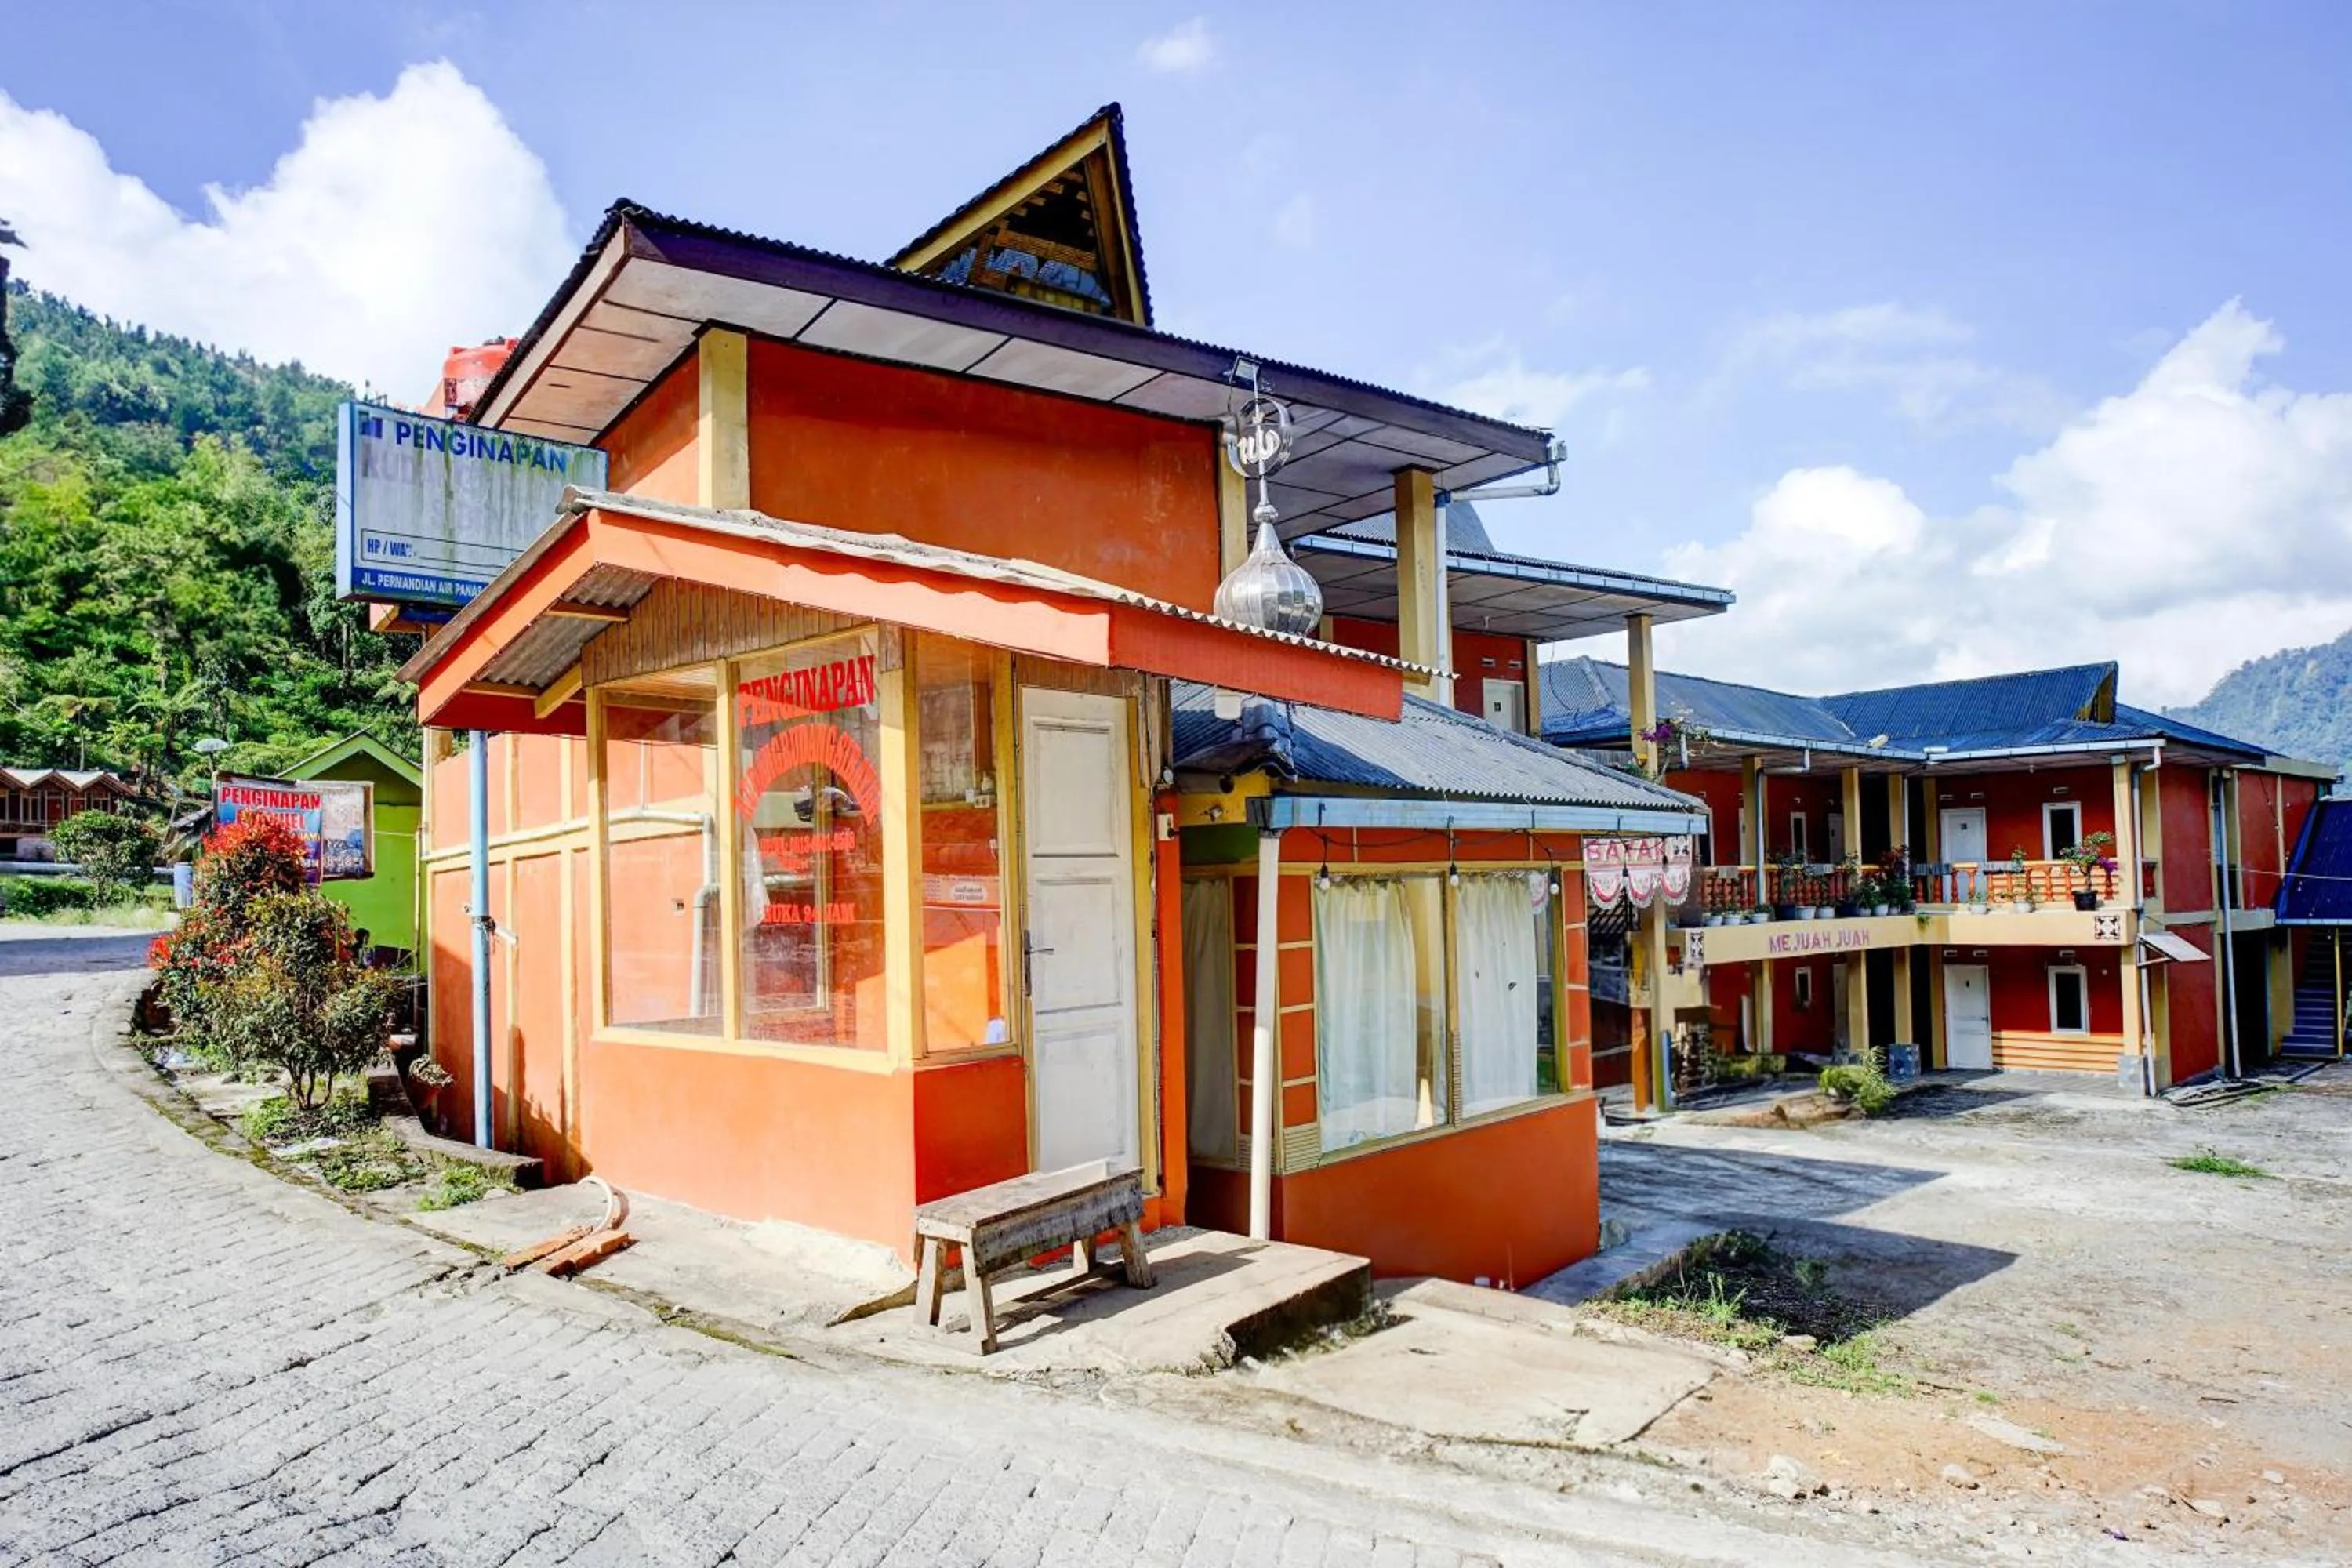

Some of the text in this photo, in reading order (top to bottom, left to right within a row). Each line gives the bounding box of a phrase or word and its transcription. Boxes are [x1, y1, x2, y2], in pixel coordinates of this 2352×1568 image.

[396, 421, 568, 474] PENGINAPAN
[368, 539, 381, 553] HP
[361, 572, 376, 586] JL.
[438, 581, 454, 594] AIR
[738, 654, 876, 728] PENGINAPAN
[221, 786, 321, 809] PENGINAPAN
[1835, 927, 1870, 948] JUAH
